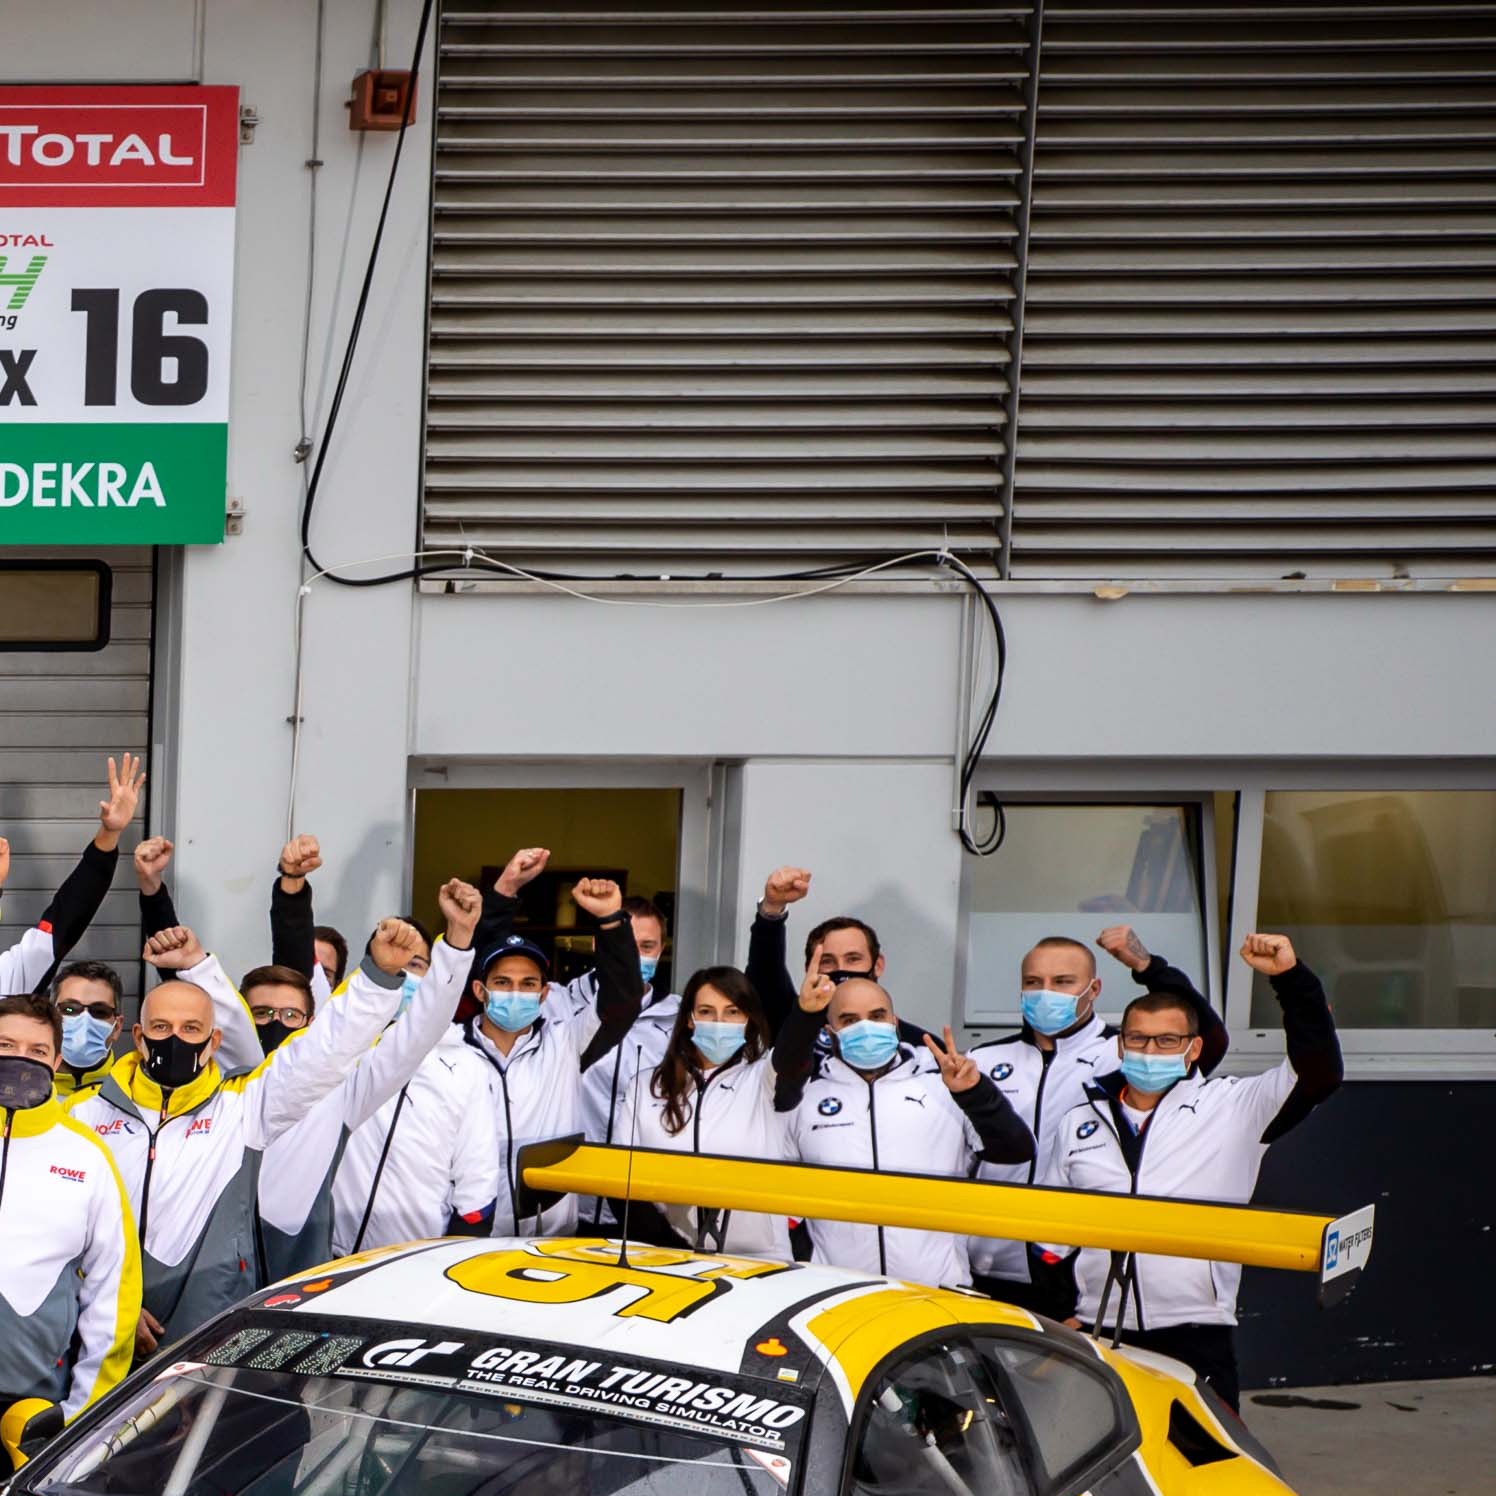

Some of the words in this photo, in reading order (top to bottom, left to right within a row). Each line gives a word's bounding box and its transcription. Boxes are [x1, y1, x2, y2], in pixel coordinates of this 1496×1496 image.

[71, 288, 209, 407] 16
[49, 1165, 87, 1181] ROWE
[467, 1369, 510, 1383] THE
[512, 1375, 561, 1393] REAL
[564, 1381, 651, 1409] DRIVING
[655, 1401, 782, 1441] SIMULATOR
[471, 1347, 602, 1383] GRAN
[598, 1366, 806, 1428] TURISMO
